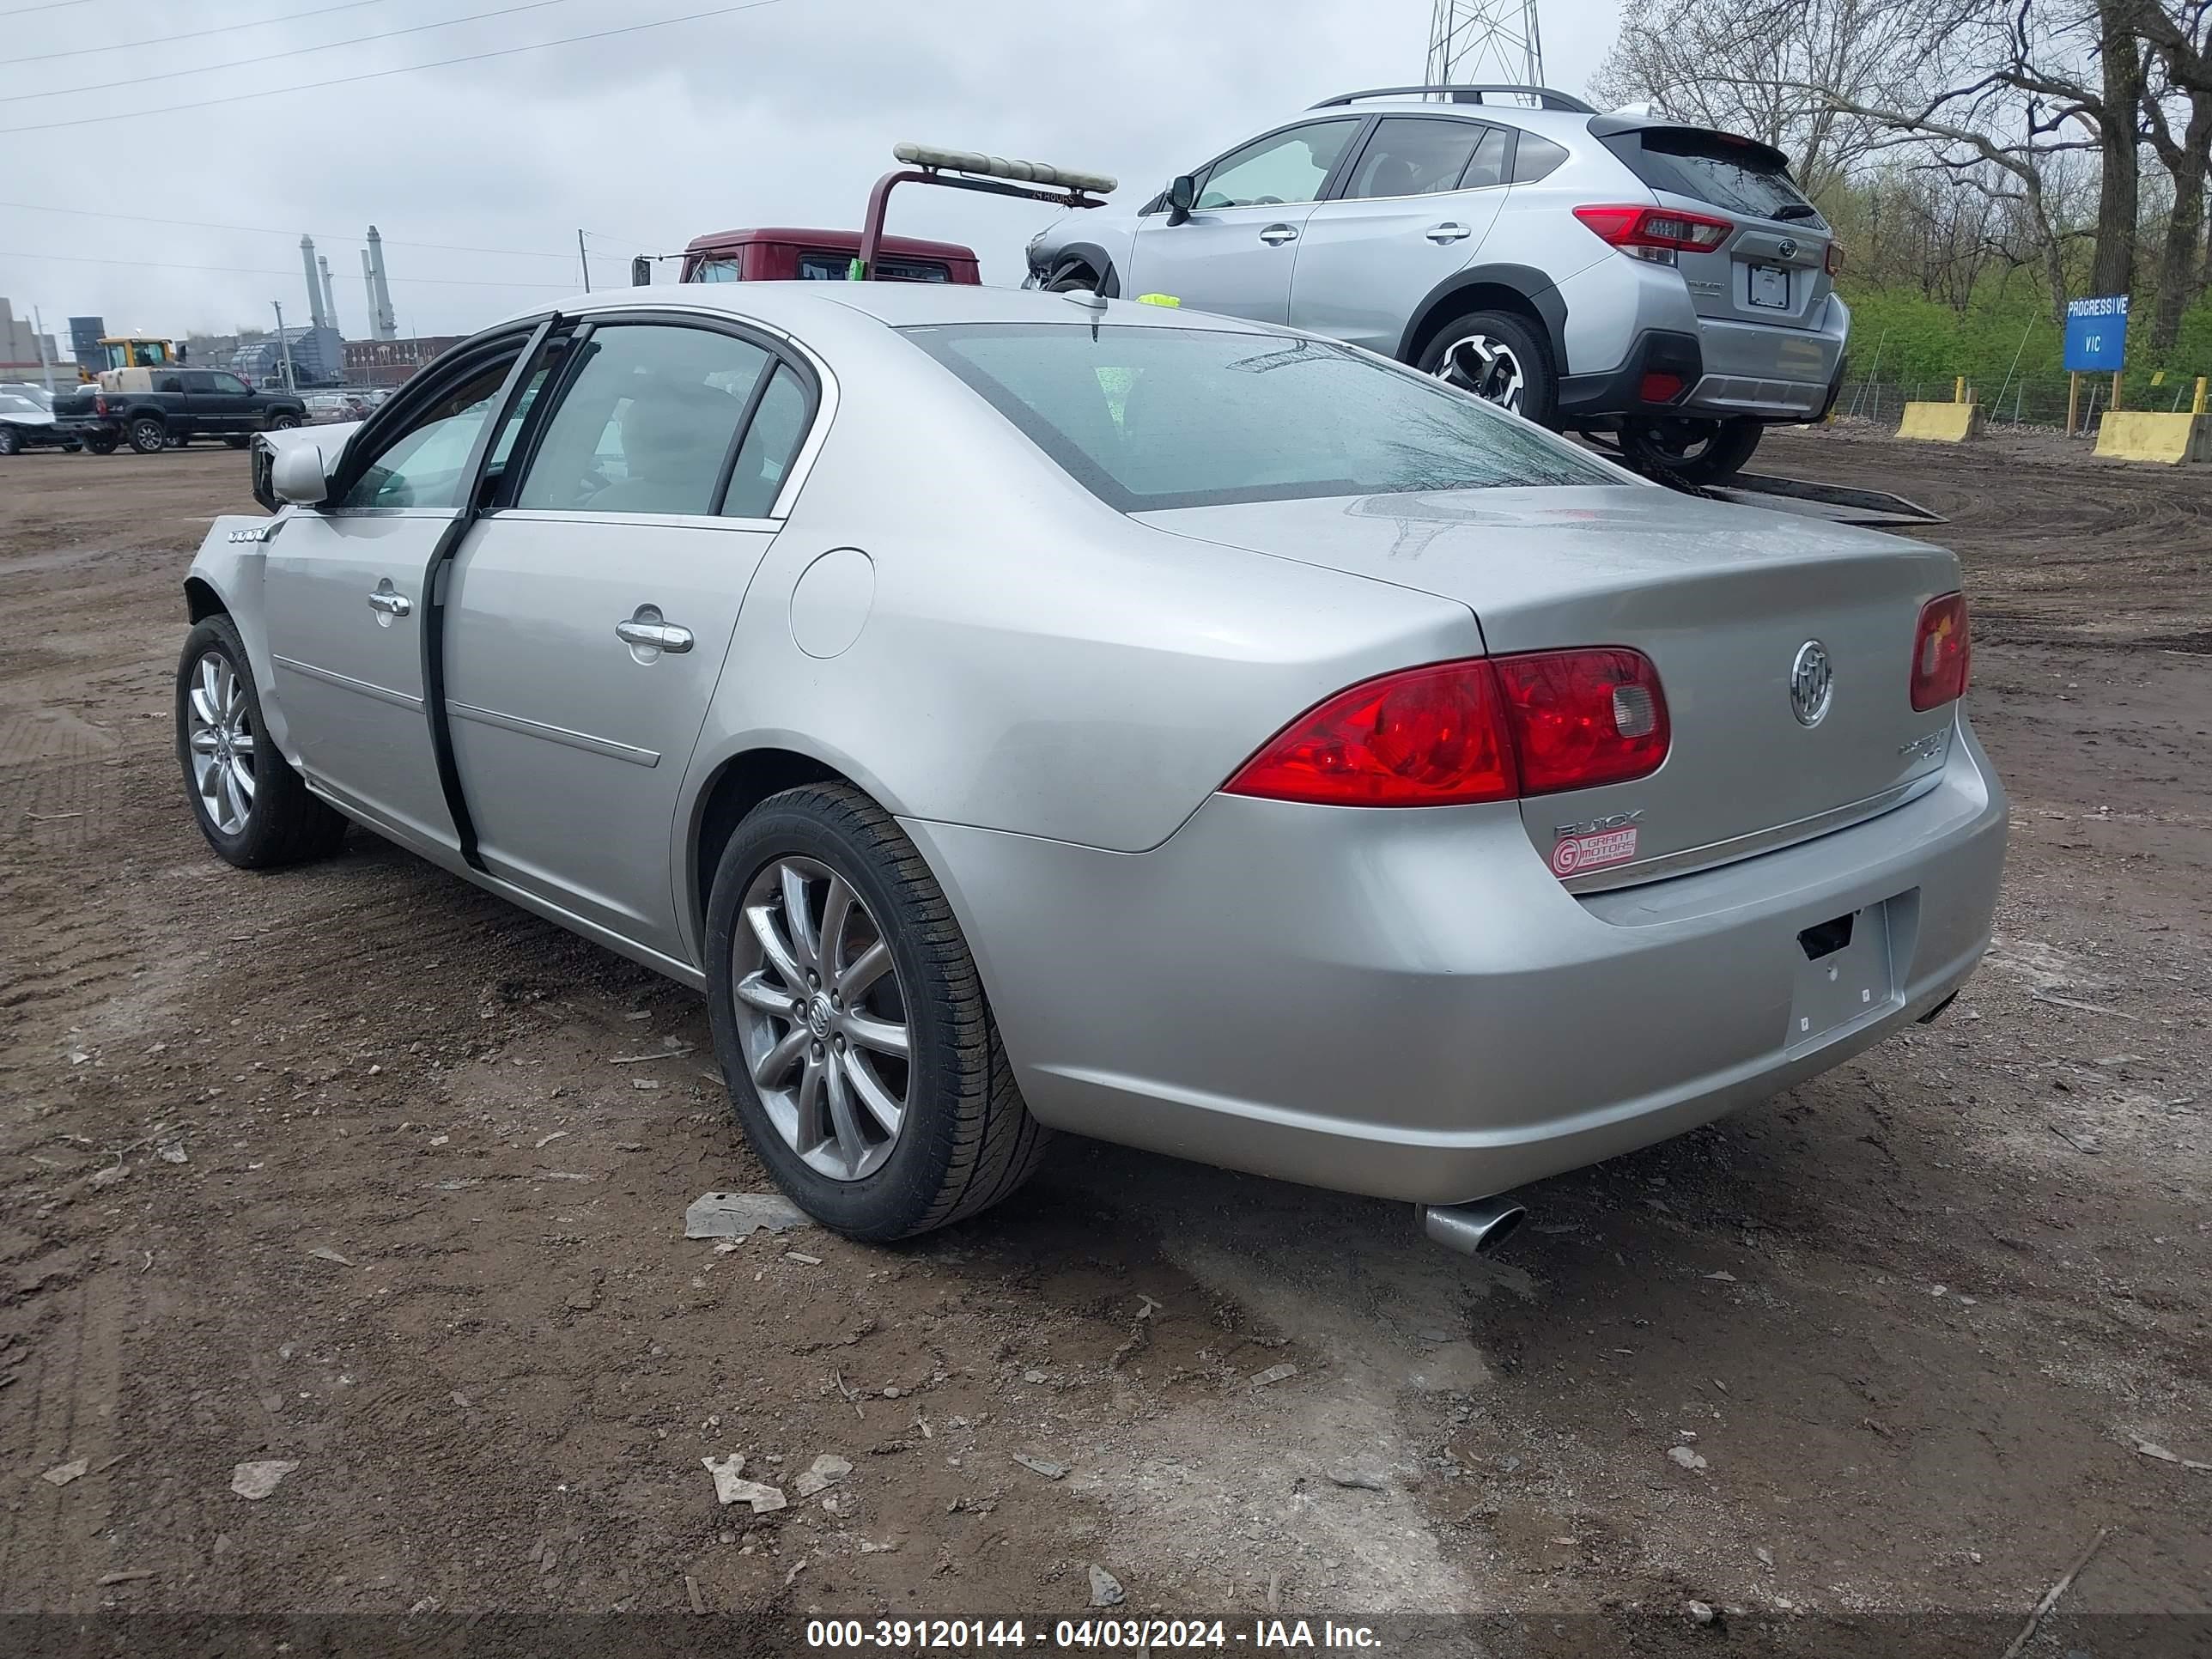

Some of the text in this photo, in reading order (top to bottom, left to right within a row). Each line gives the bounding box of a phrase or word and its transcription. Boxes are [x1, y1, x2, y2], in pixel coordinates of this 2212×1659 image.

[1044, 191, 1074, 204] HOURS
[2067, 296, 2129, 318] PROGRESSIVE
[2086, 336, 2101, 352] VIC
[1554, 809, 1644, 839] BUICK
[1588, 832, 1630, 848] GRANT
[1582, 841, 1634, 858] MOTORS
